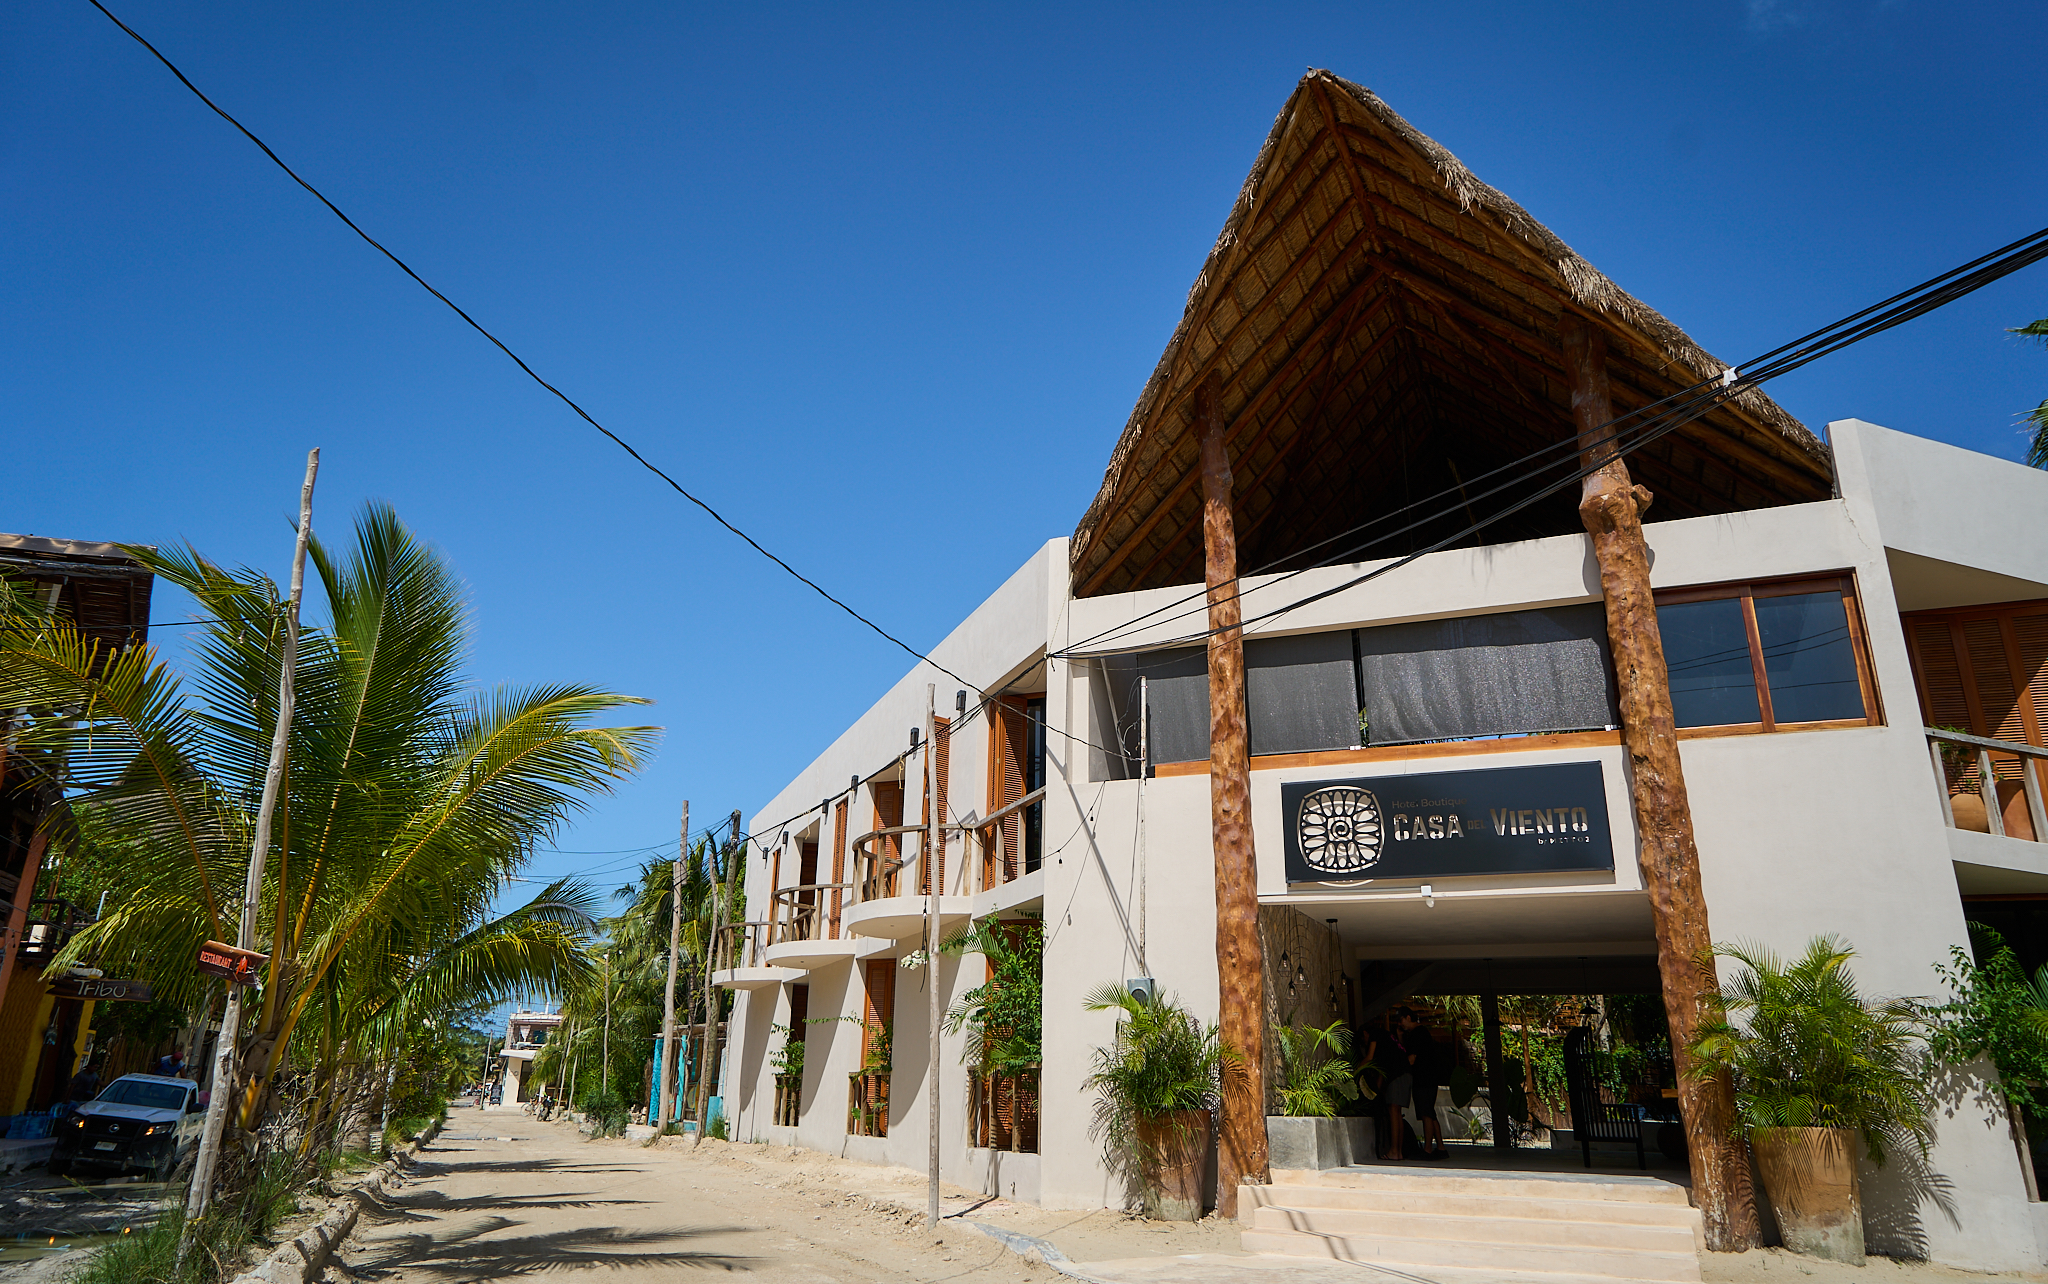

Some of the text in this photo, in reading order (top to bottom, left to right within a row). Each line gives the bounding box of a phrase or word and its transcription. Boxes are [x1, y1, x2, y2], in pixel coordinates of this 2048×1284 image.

[1421, 798, 1467, 808] Boutique
[1393, 807, 1589, 841] CASA DEL VIENTO
